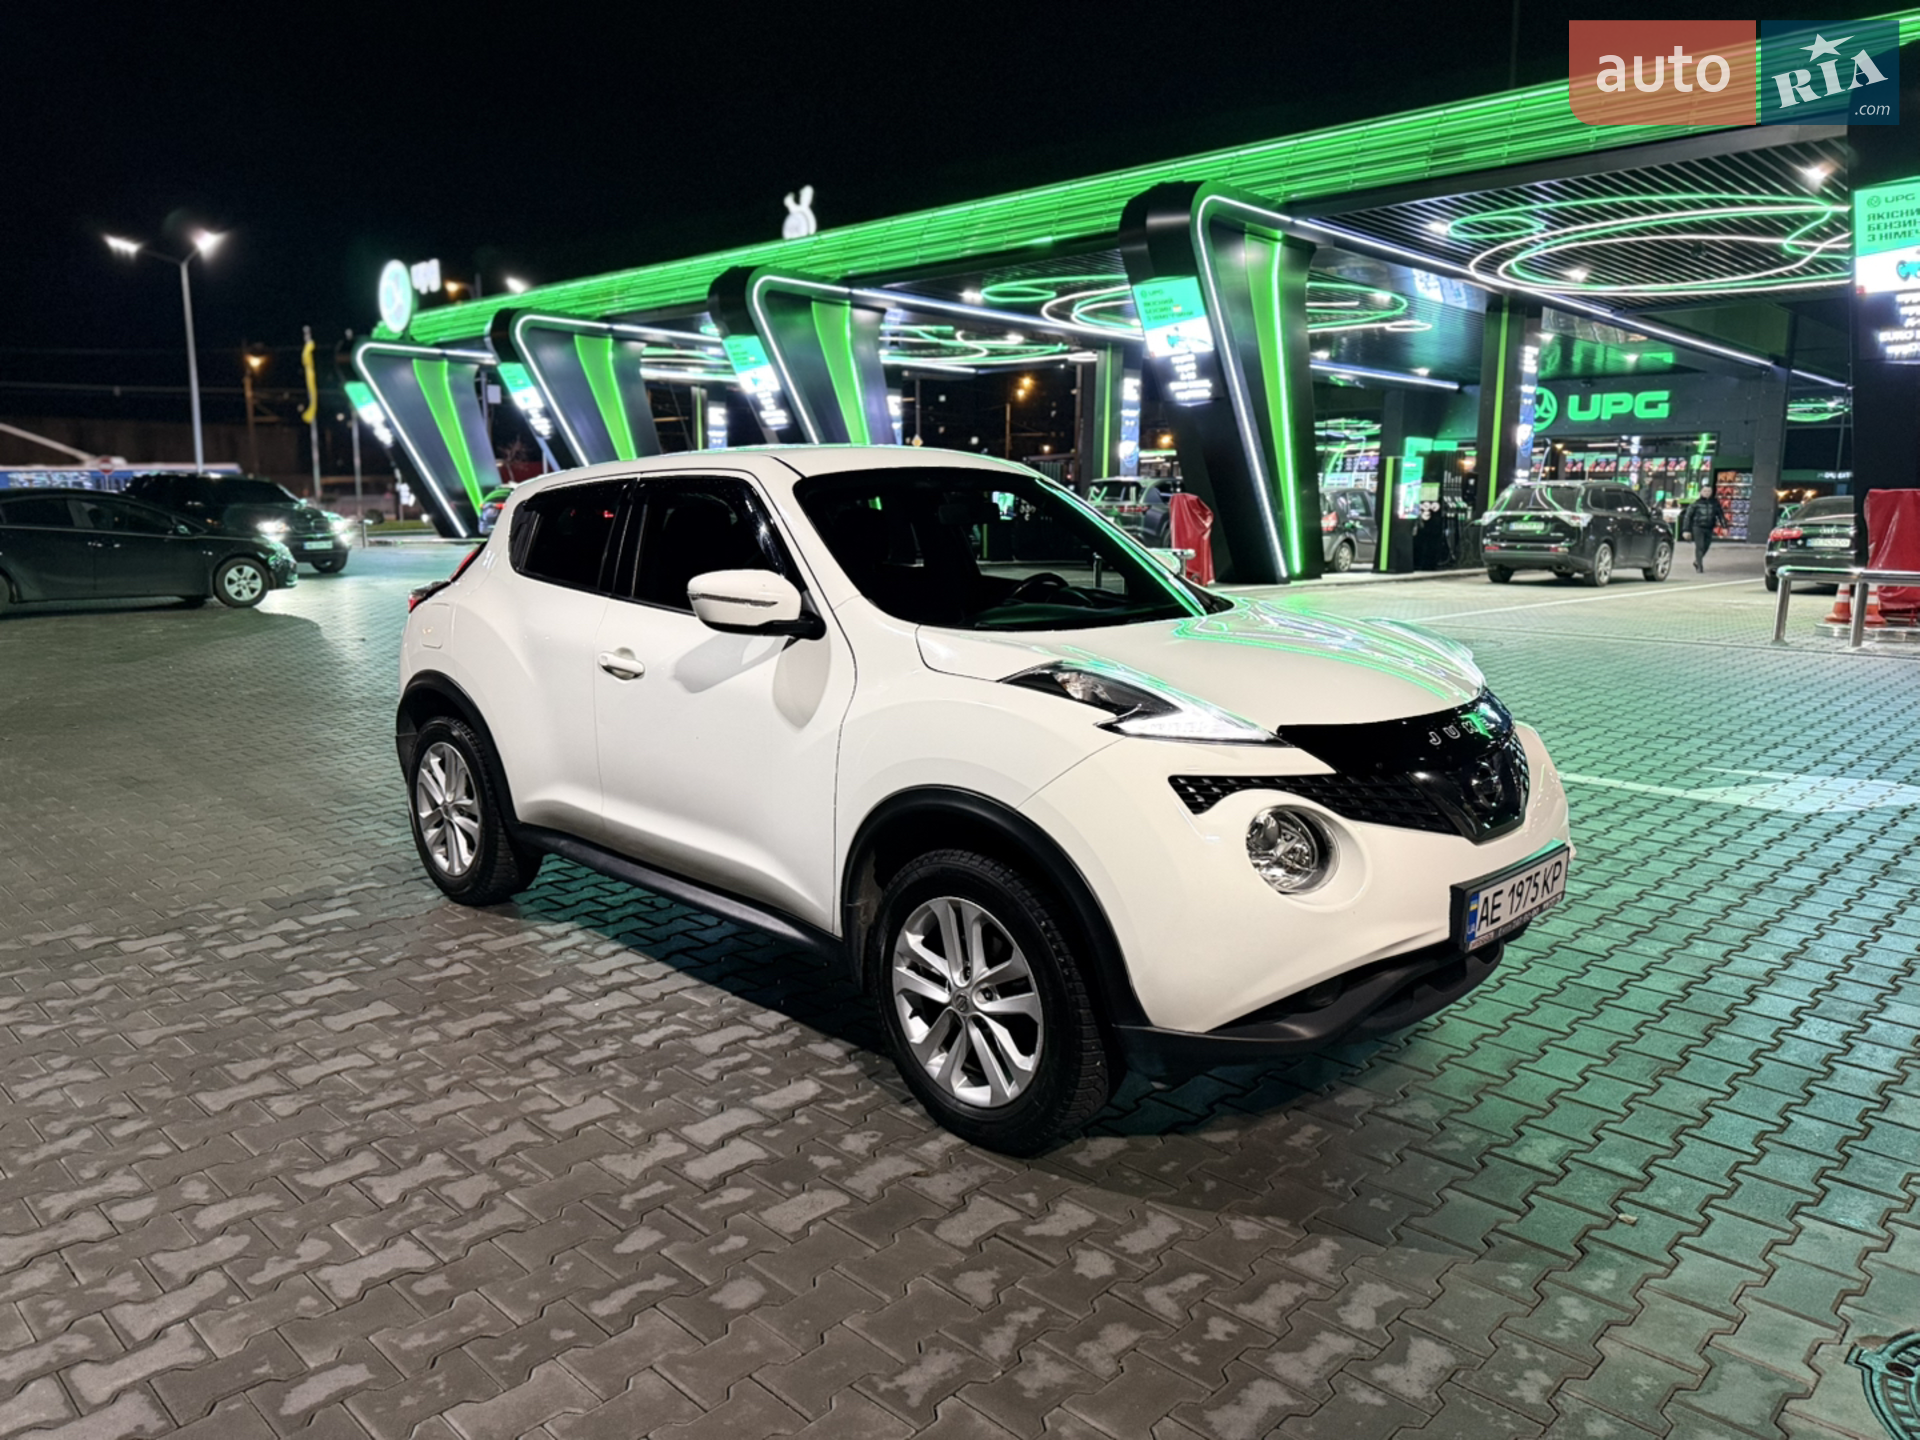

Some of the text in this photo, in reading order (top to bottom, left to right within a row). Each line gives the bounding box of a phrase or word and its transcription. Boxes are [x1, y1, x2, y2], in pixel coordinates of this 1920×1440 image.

[1884, 193, 1916, 204] UPG
[1567, 390, 1672, 421] UPG
[1477, 888, 1504, 932] AE
[1507, 870, 1541, 915] 1975
[1541, 860, 1563, 898] KP
